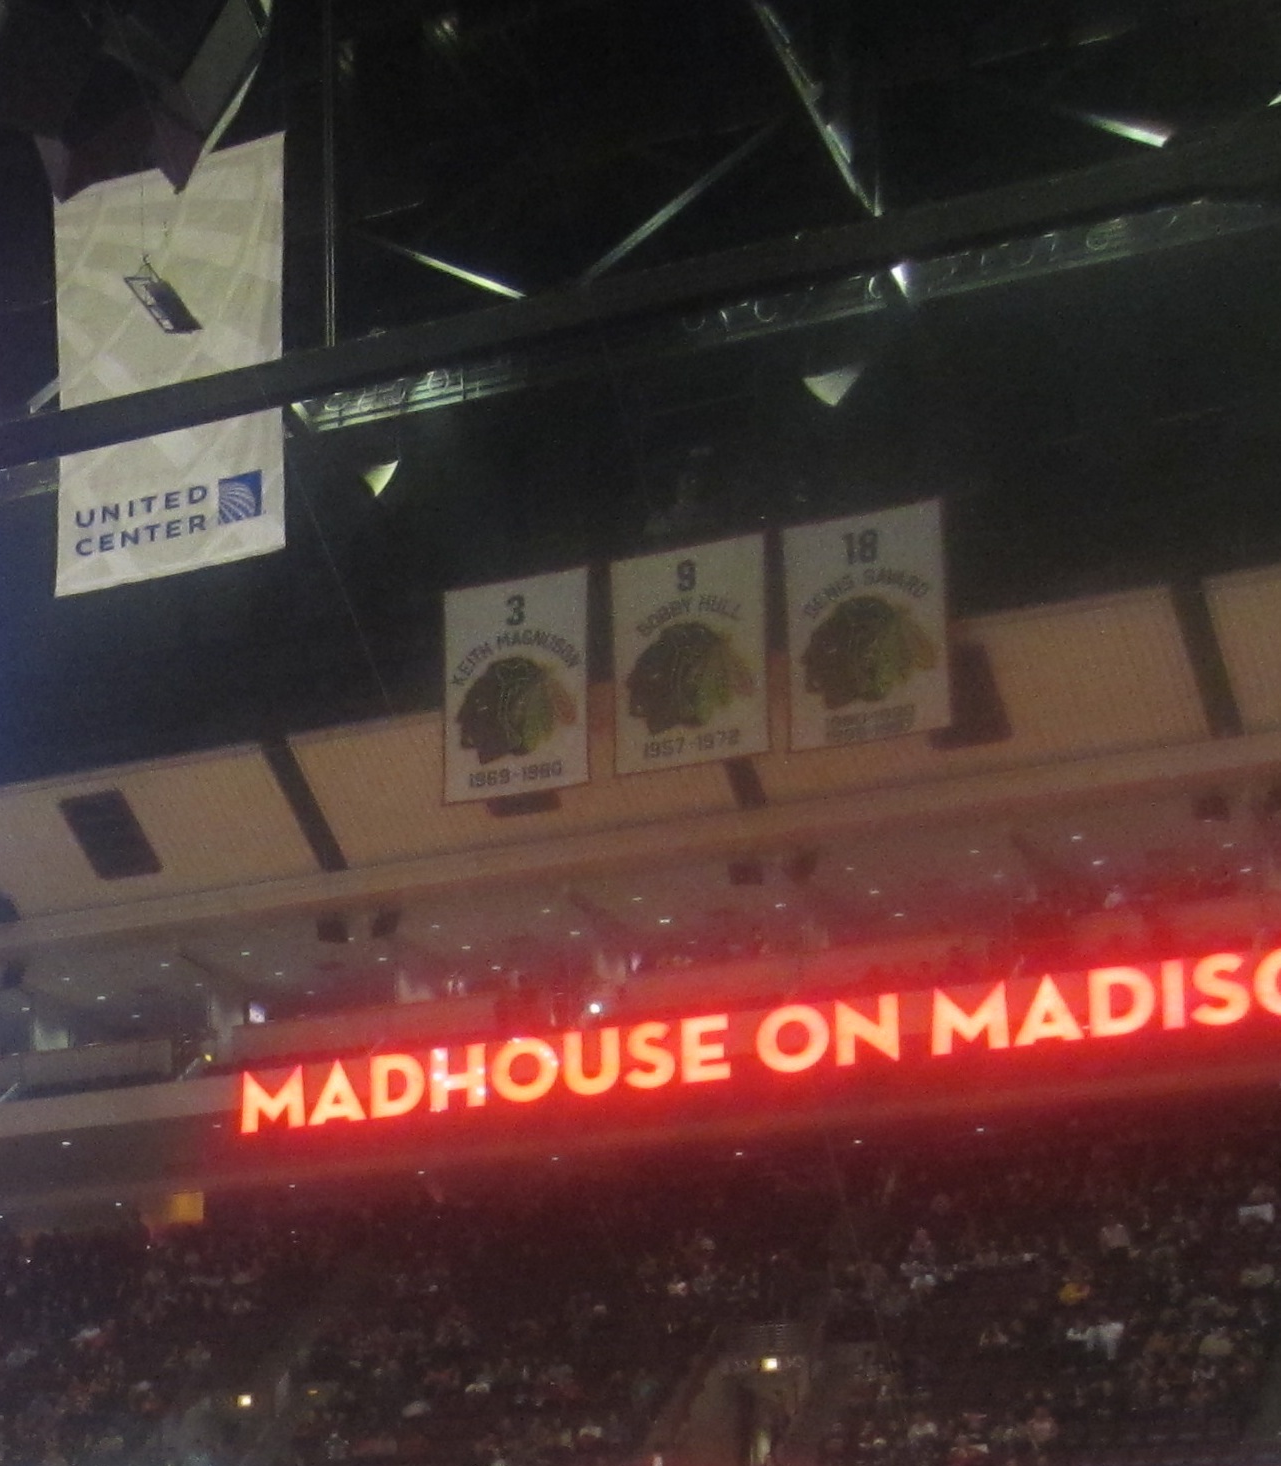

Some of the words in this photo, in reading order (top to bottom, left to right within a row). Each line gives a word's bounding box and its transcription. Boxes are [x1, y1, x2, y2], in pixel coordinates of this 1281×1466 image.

[75, 485, 208, 529] UNITED
[75, 514, 207, 557] CENTER
[844, 529, 879, 565] 18
[676, 559, 697, 592] 9
[506, 594, 526, 626] 3
[240, 1015, 732, 1135] MADHOUSE
[756, 995, 900, 1077] ON
